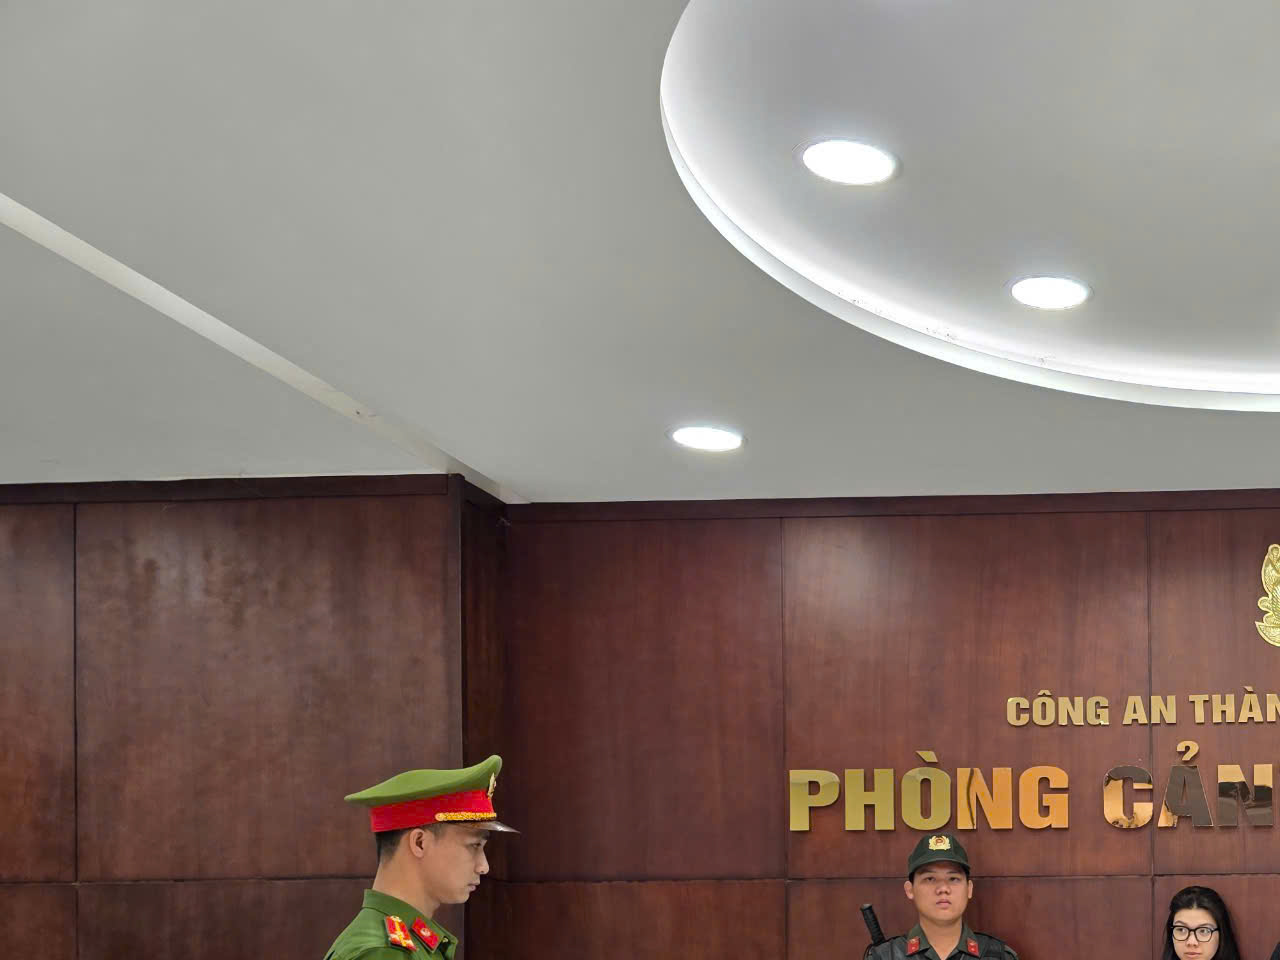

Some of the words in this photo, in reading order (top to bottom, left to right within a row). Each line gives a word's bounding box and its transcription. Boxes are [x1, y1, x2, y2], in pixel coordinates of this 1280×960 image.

[1006, 690, 1110, 726] CÔNG
[1122, 695, 1178, 724] AN
[788, 750, 1070, 832] PHÒNG
